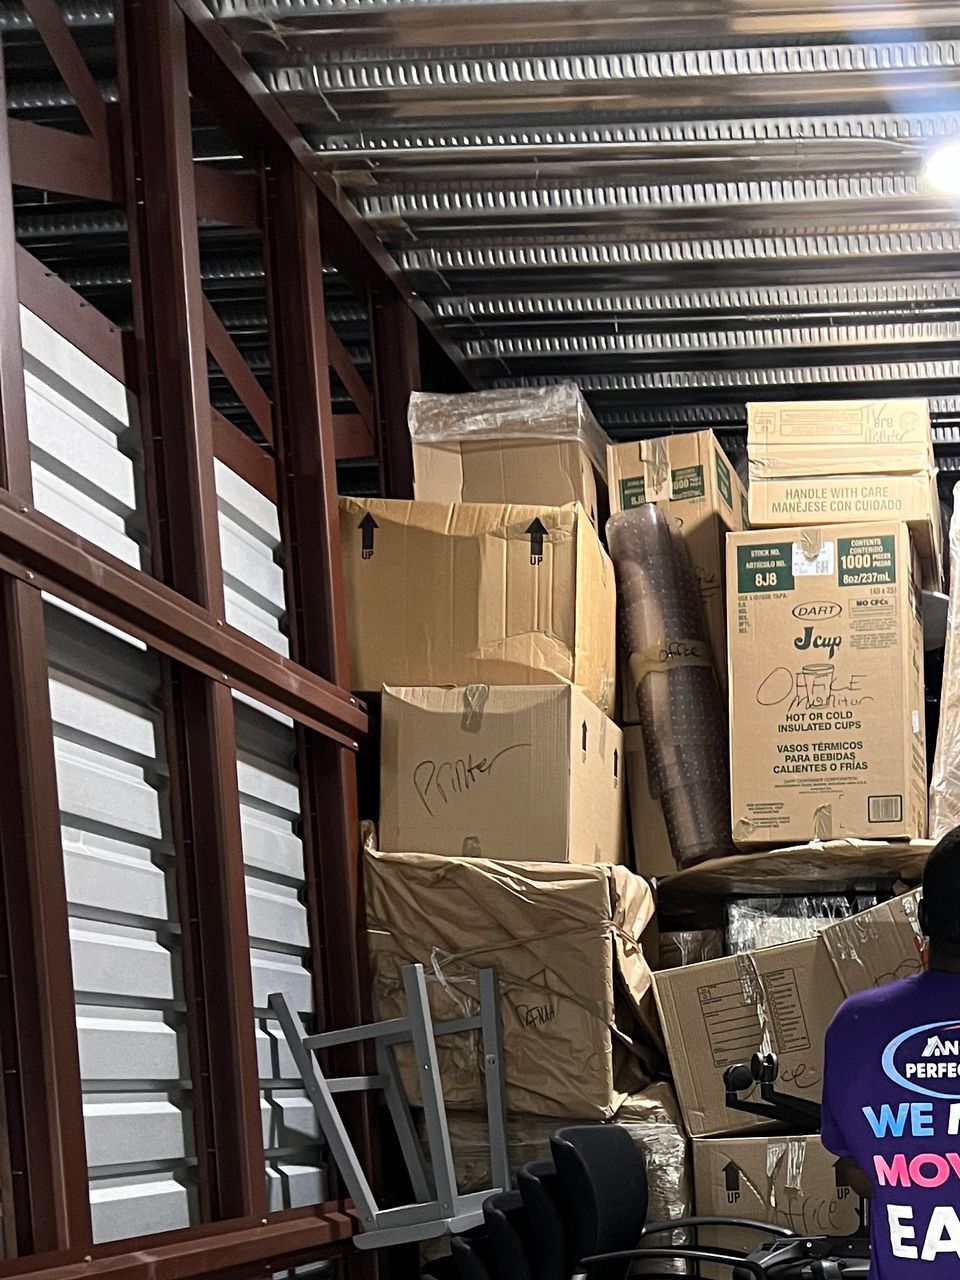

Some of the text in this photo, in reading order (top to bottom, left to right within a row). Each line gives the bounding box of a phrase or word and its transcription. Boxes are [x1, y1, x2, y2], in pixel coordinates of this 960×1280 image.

[785, 486, 889, 500] HANDLE WITH CARE
[830, 501, 851, 511] CON
[855, 500, 903, 511] CUIDADO
[850, 538, 881, 547] CONTENTS
[361, 550, 374, 560] UP
[529, 556, 543, 566] UP
[840, 555, 872, 569] 1000
[755, 572, 777, 587] 8J8
[843, 571, 891, 585] 8oz/237mL
[870, 598, 889, 606] CFCs
[798, 605, 837, 617] DART
[786, 711, 853, 722] HOT OR COLD
[777, 720, 862, 733] INSULATED CUPS
[776, 741, 863, 753] VASOS TÉRMICOS
[784, 752, 856, 763] PARA BEBIDAS
[773, 760, 868, 774] CALIENTES O FRÍAS
[413, 743, 532, 817] Printer
[861, 1102, 935, 1138] WE
[727, 1193, 741, 1204] UP
[836, 1187, 850, 1200] UP
